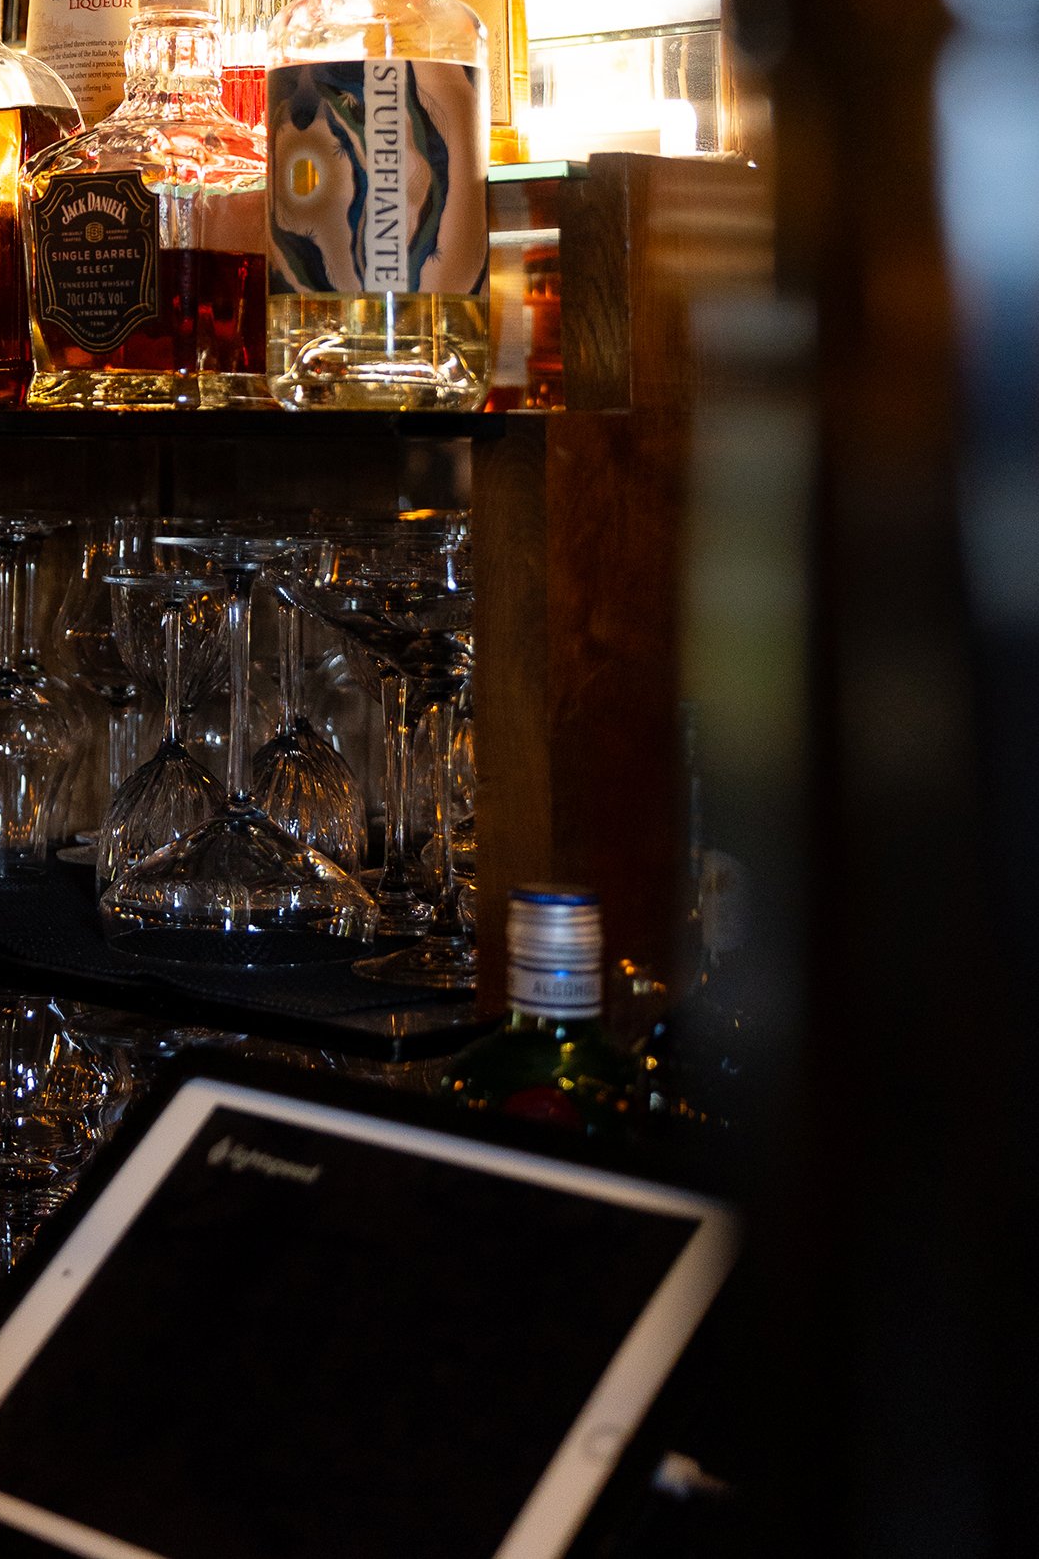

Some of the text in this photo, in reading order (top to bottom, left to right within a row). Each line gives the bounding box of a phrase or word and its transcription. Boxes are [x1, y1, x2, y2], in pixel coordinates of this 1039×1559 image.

[61, 191, 129, 225] JACK DANIEL'S
[51, 248, 141, 262] SINGLE BARREL
[76, 264, 114, 275] SELECT
[58, 279, 135, 289] TENNESSEE WHISKEY
[77, 309, 118, 317] LYNCHBURG
